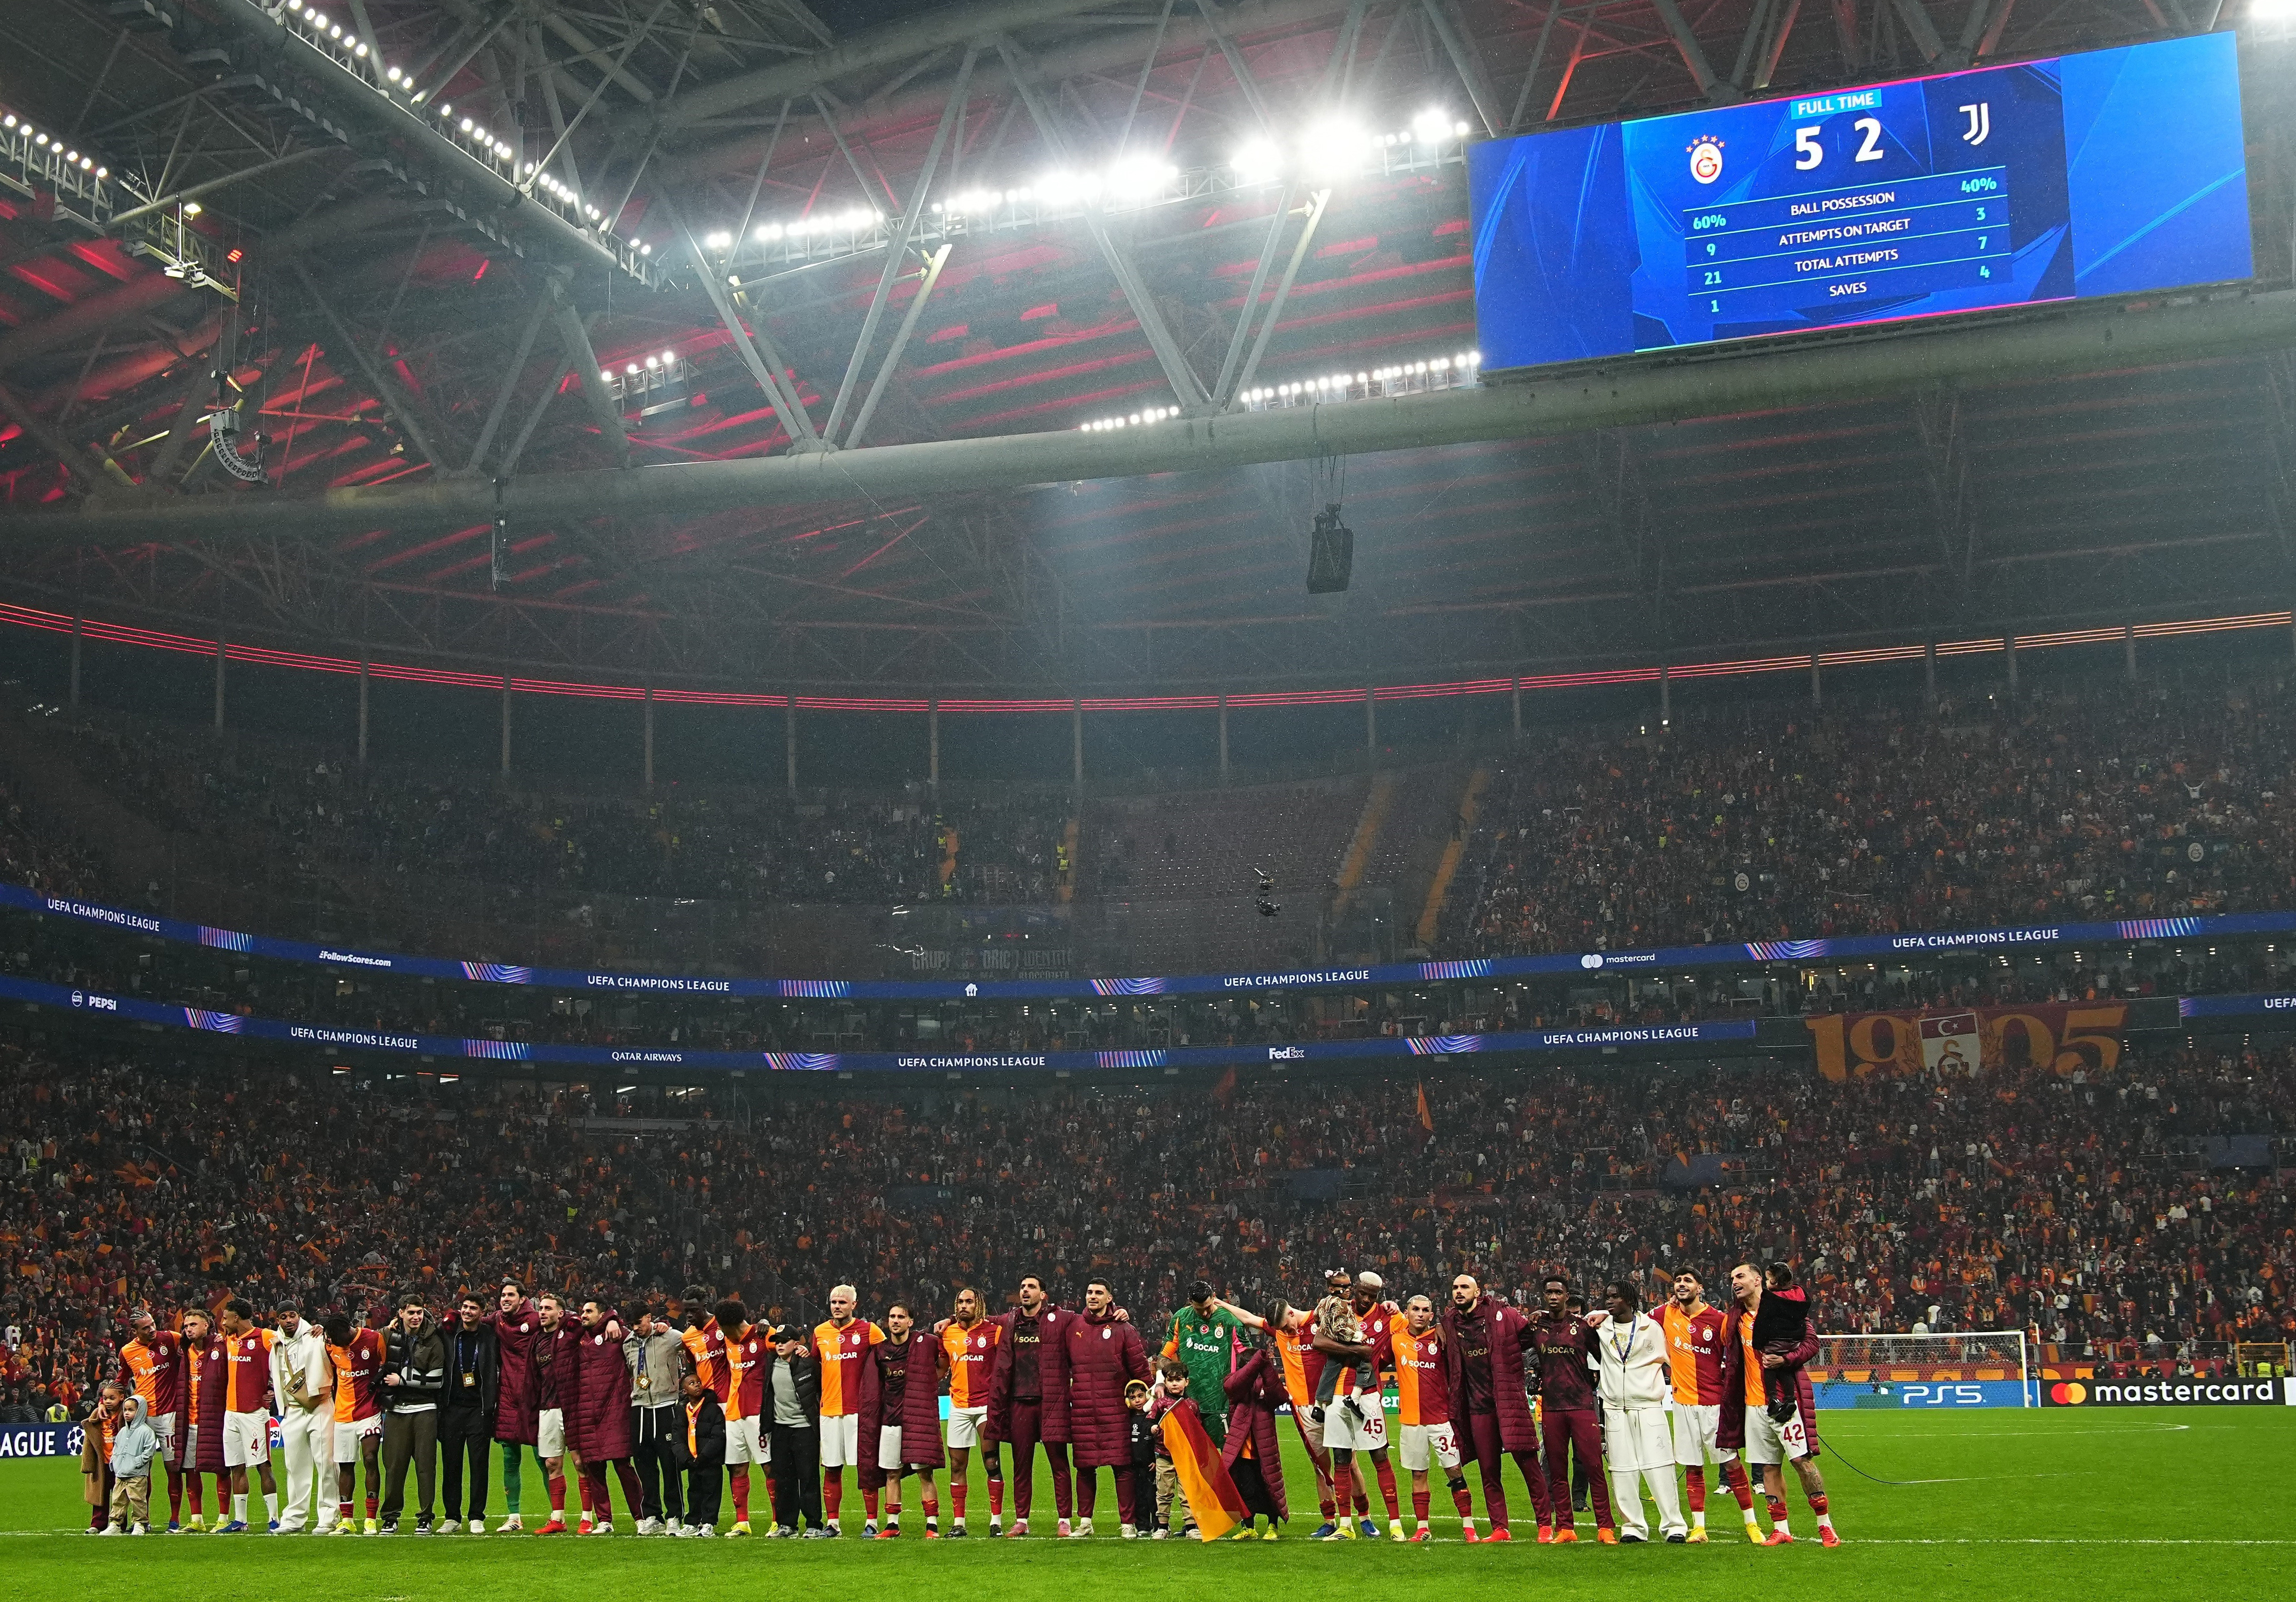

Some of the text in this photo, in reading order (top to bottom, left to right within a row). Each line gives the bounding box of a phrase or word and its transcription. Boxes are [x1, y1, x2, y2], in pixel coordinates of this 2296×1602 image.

[1798, 92, 1875, 116] FULL TIME
[1796, 118, 1884, 170] 5 2
[1961, 177, 1997, 193] 40%
[1791, 191, 1894, 216] BALL POSSESSION
[1976, 207, 1986, 221] 3
[1693, 214, 1727, 230] 60%
[1779, 218, 1910, 245] ATTEMPTS ON TARGET
[1706, 243, 1716, 256] 9
[1978, 236, 1987, 250] 7
[1794, 249, 1899, 272] TOTAL ATTEMPTS
[1704, 271, 1722, 285] 21
[1980, 265, 1990, 278] 4
[1829, 282, 1867, 297] SAVES
[1711, 300, 1719, 313] 1
[48, 898, 160, 931] UEFA CHAMPIONS LEAGUE
[1893, 929, 2059, 948] UEFA CHAMPIONS LEAGUE
[323, 950, 391, 967] FollowScores.com
[1606, 953, 1655, 963] mastercard
[588, 975, 729, 991] UEFA CHAMPIONS LEAGUE
[1224, 970, 1369, 986] UEFA CHAMPIONS LEAGUE
[89, 996, 117, 1010] PEPSI
[2264, 998, 2296, 1008] UEFA
[291, 1027, 418, 1049] UEFA CHAMPIONS LEAGUE
[1544, 1027, 1698, 1044] UEFA CHAMPIONS LEAGUE
[612, 1051, 682, 1062] QATAR AIRWAYS
[1269, 1047, 1305, 1059] FedEx
[899, 1057, 1045, 1067] UEFA CHAMPIONS LEAGUE
[701, 1348, 725, 1360] SOCAR
[1193, 1343, 1219, 1353] SOCAR
[1468, 1349, 1488, 1357] SOCA
[1682, 1343, 1711, 1355] SOCAR
[540, 1354, 552, 1363] SOC
[832, 1352, 857, 1360] SOCAR
[148, 1362, 169, 1374] SOCAR
[1408, 1360, 1436, 1369] SOCAR
[346, 1369, 369, 1378] SOCAR
[1903, 1385, 1981, 1404] PS5
[2095, 1380, 2273, 1402] mastercard
[1221, 1418, 1229, 1434] 1
[1363, 1418, 1382, 1434] 45
[1783, 1423, 1804, 1442] 42
[0, 1431, 55, 1457] AGUE
[251, 1438, 258, 1451] 4
[758, 1435, 767, 1449] 8
[1439, 1436, 1458, 1452] 34
